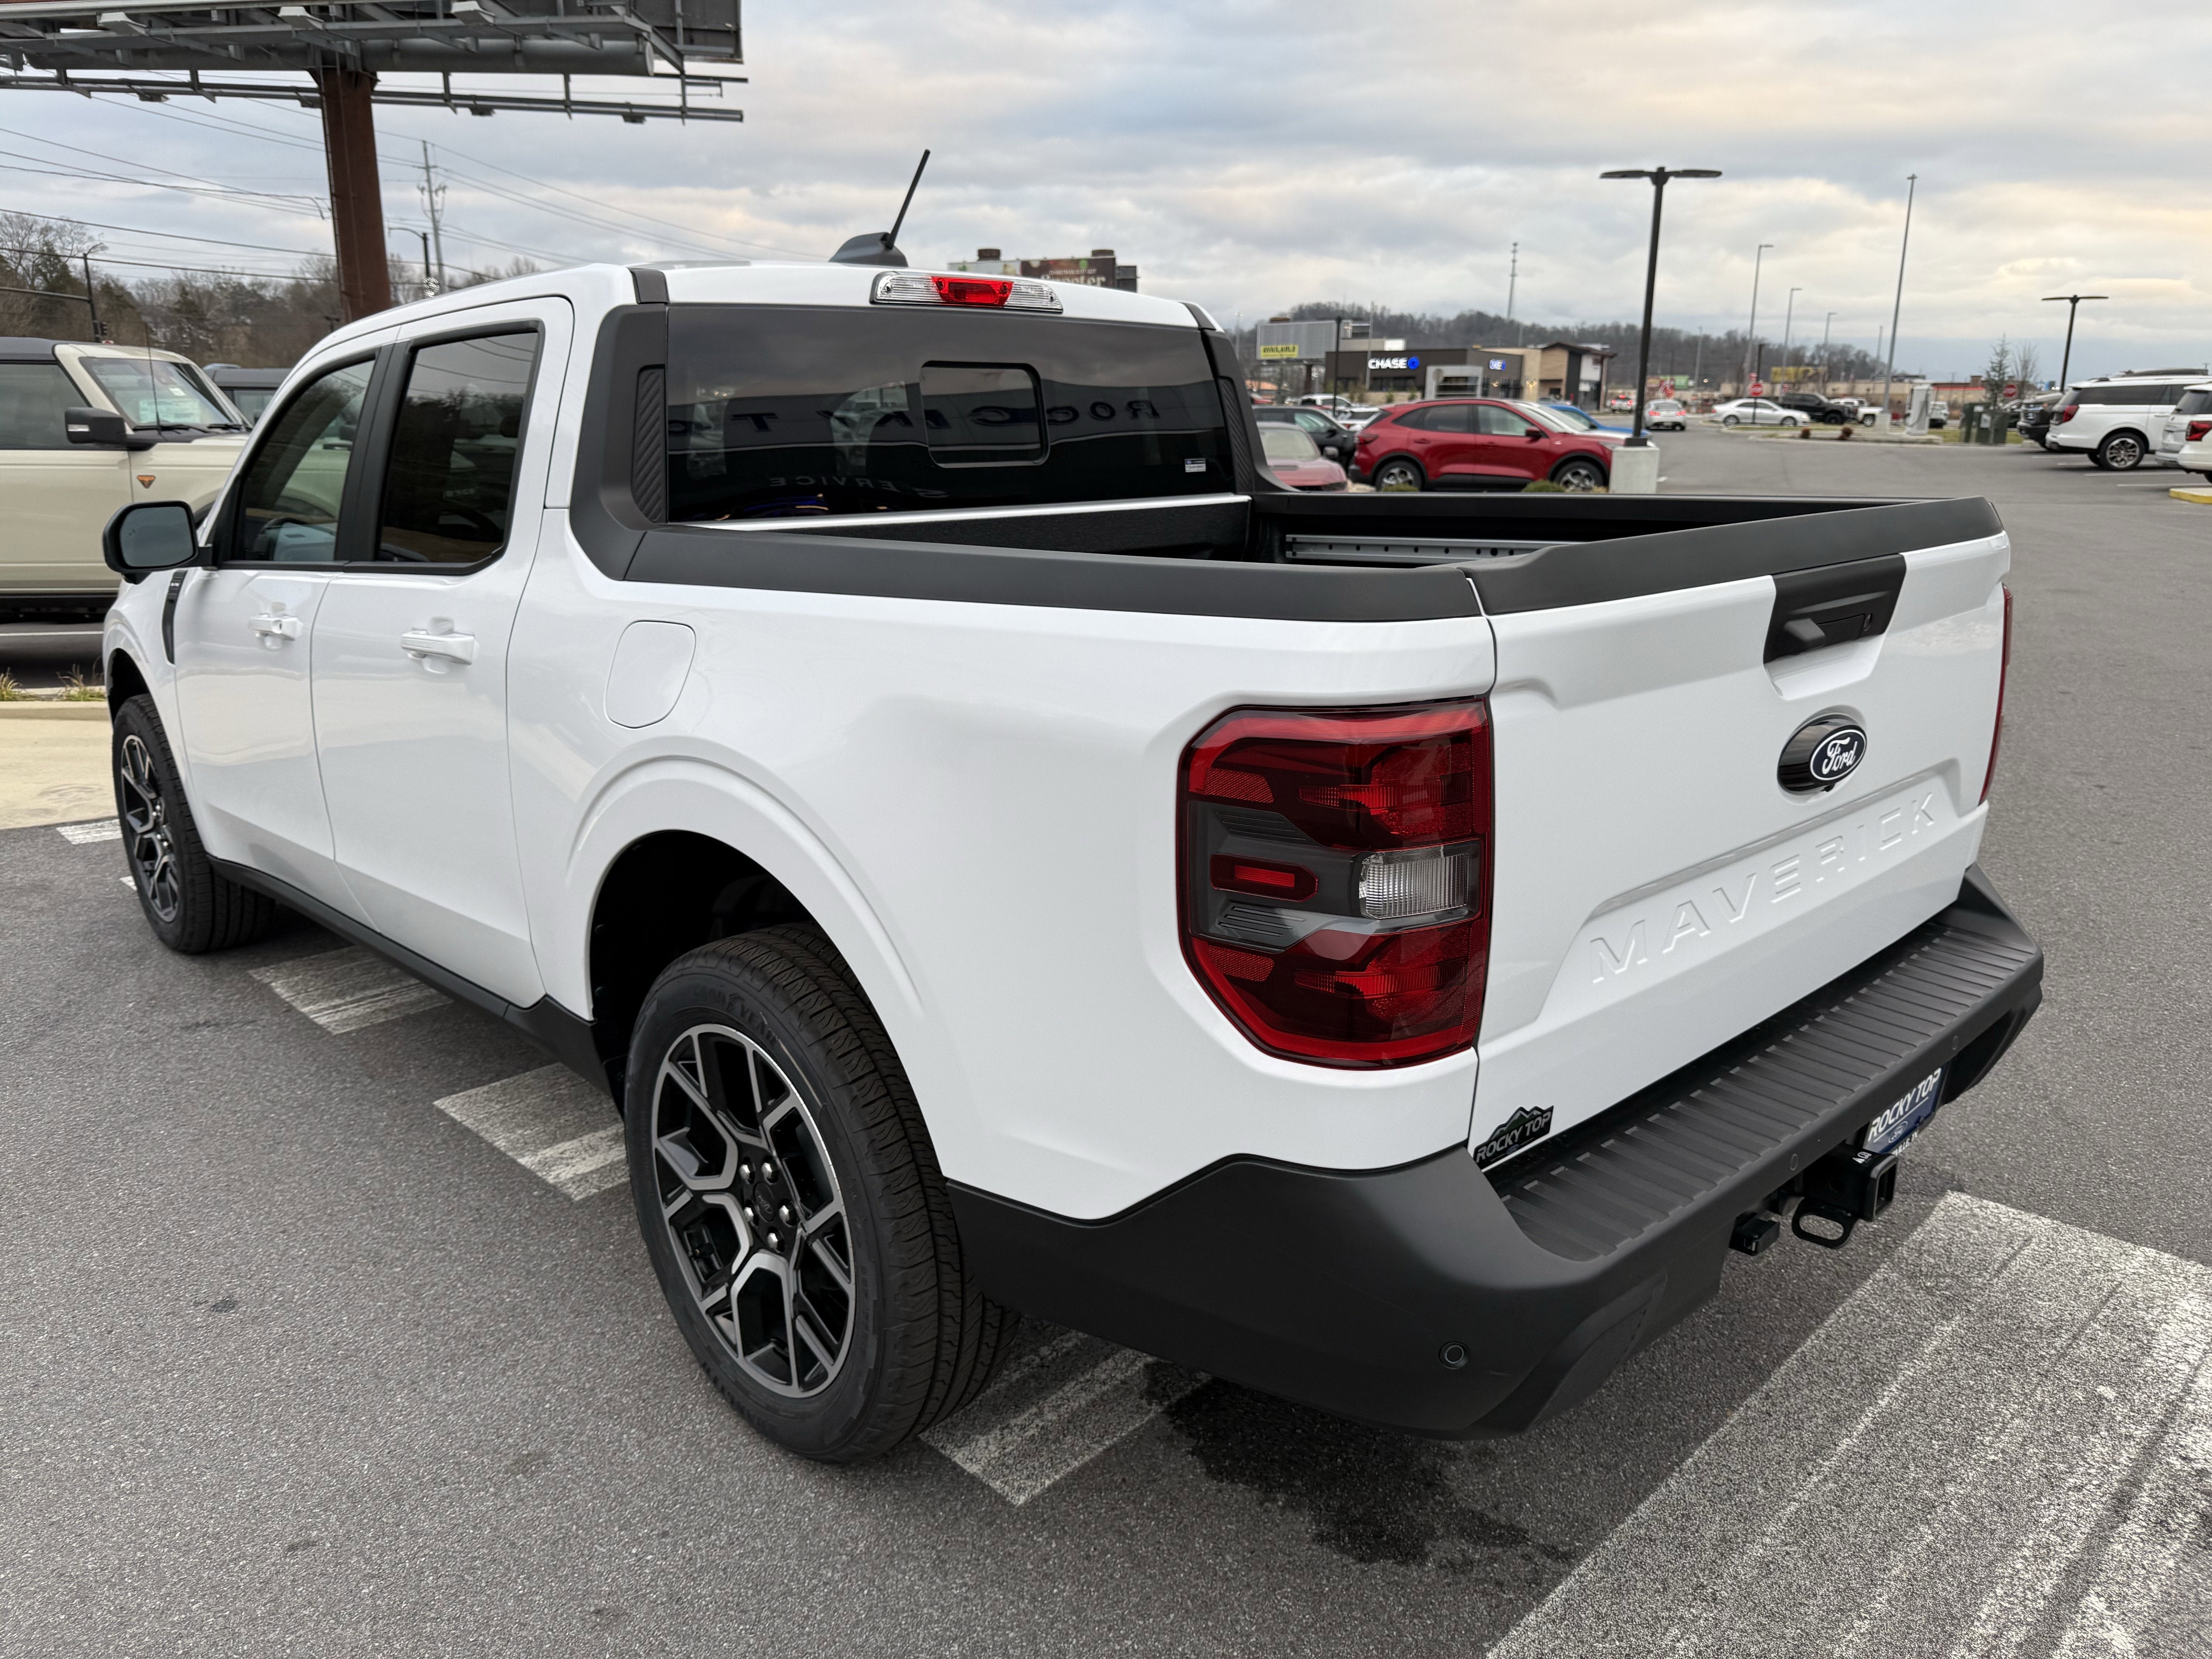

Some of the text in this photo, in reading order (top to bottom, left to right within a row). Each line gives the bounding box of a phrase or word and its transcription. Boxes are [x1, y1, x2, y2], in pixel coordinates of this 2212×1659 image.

[1368, 357, 1408, 369] CHASE
[1822, 737, 1858, 775] Ford
[1590, 792, 1934, 984] MAVERICK
[1867, 1087, 1917, 1142] ROCKY
[1915, 1067, 1942, 1103] TOP
[1476, 1111, 1551, 1163] ROCKY TOP
